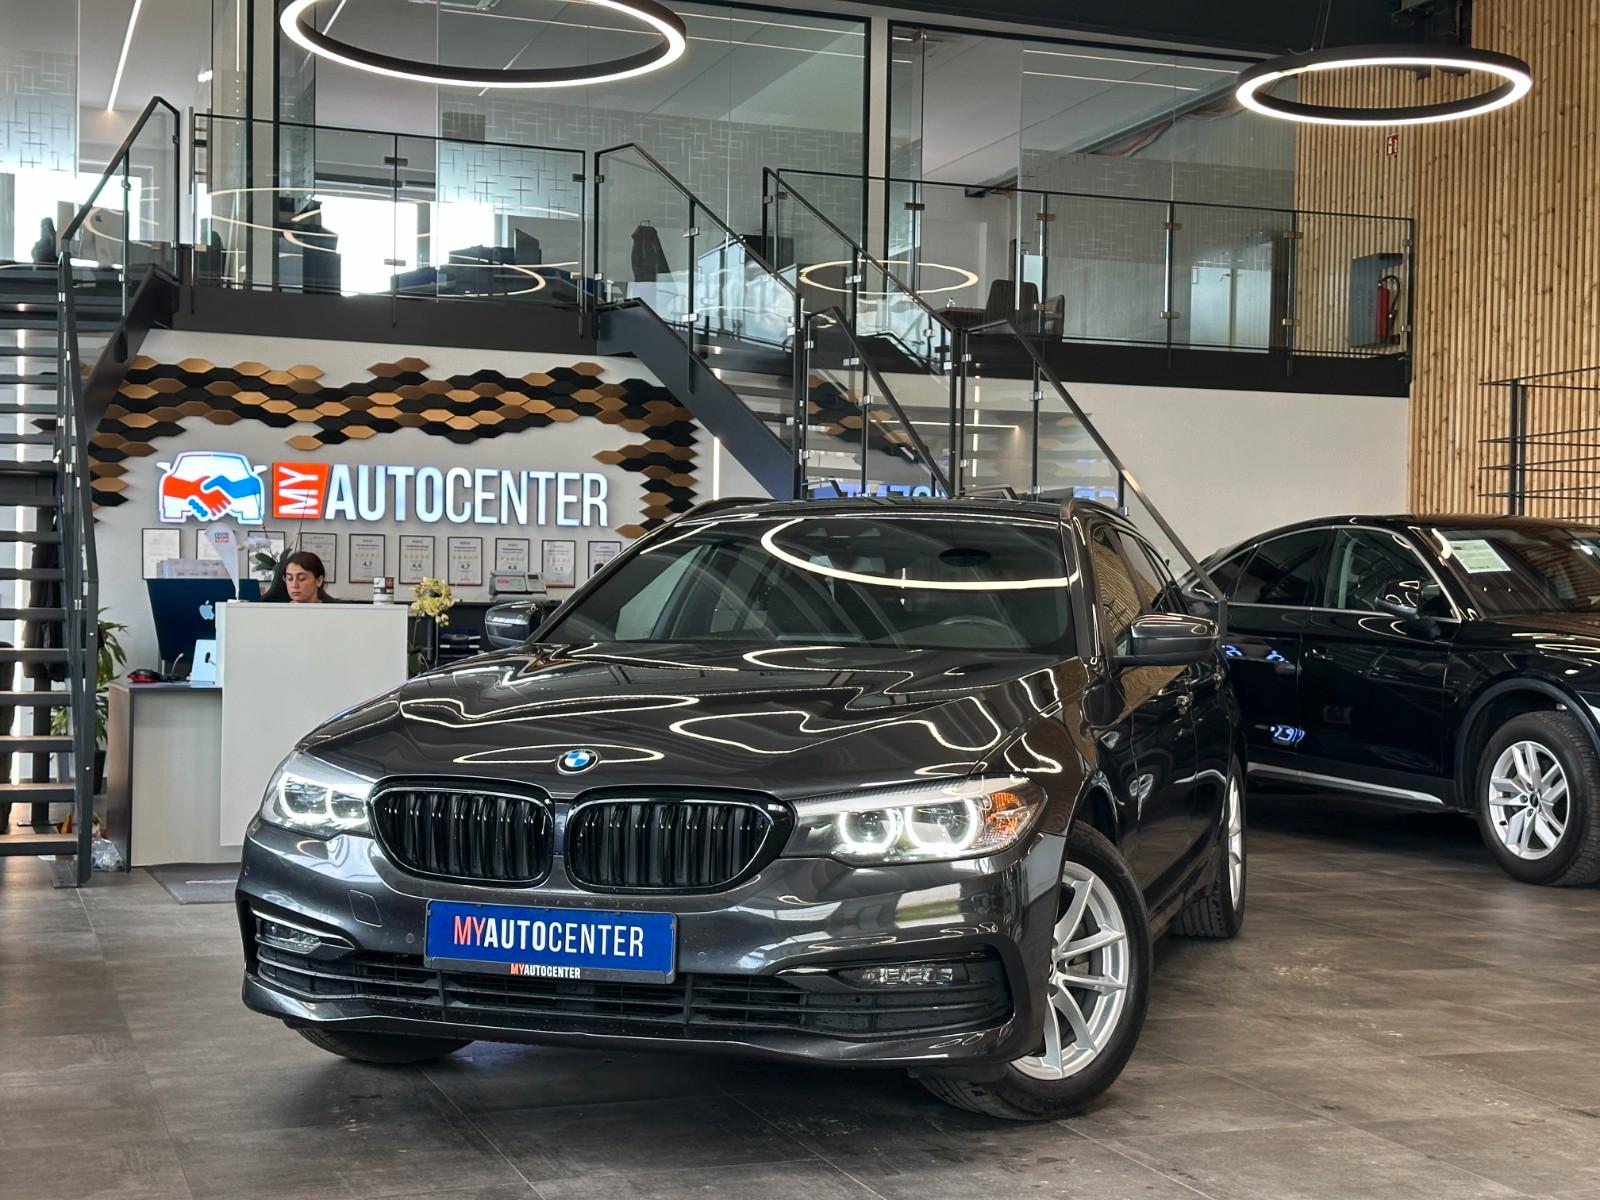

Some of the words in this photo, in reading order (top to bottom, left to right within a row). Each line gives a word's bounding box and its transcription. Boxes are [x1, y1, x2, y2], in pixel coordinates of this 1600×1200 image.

[278, 466, 318, 514] MY
[325, 463, 608, 527] AUTOCENTER
[453, 915, 644, 957] MYAUTOCENTER
[510, 963, 581, 979] MYAUTOCENTER
